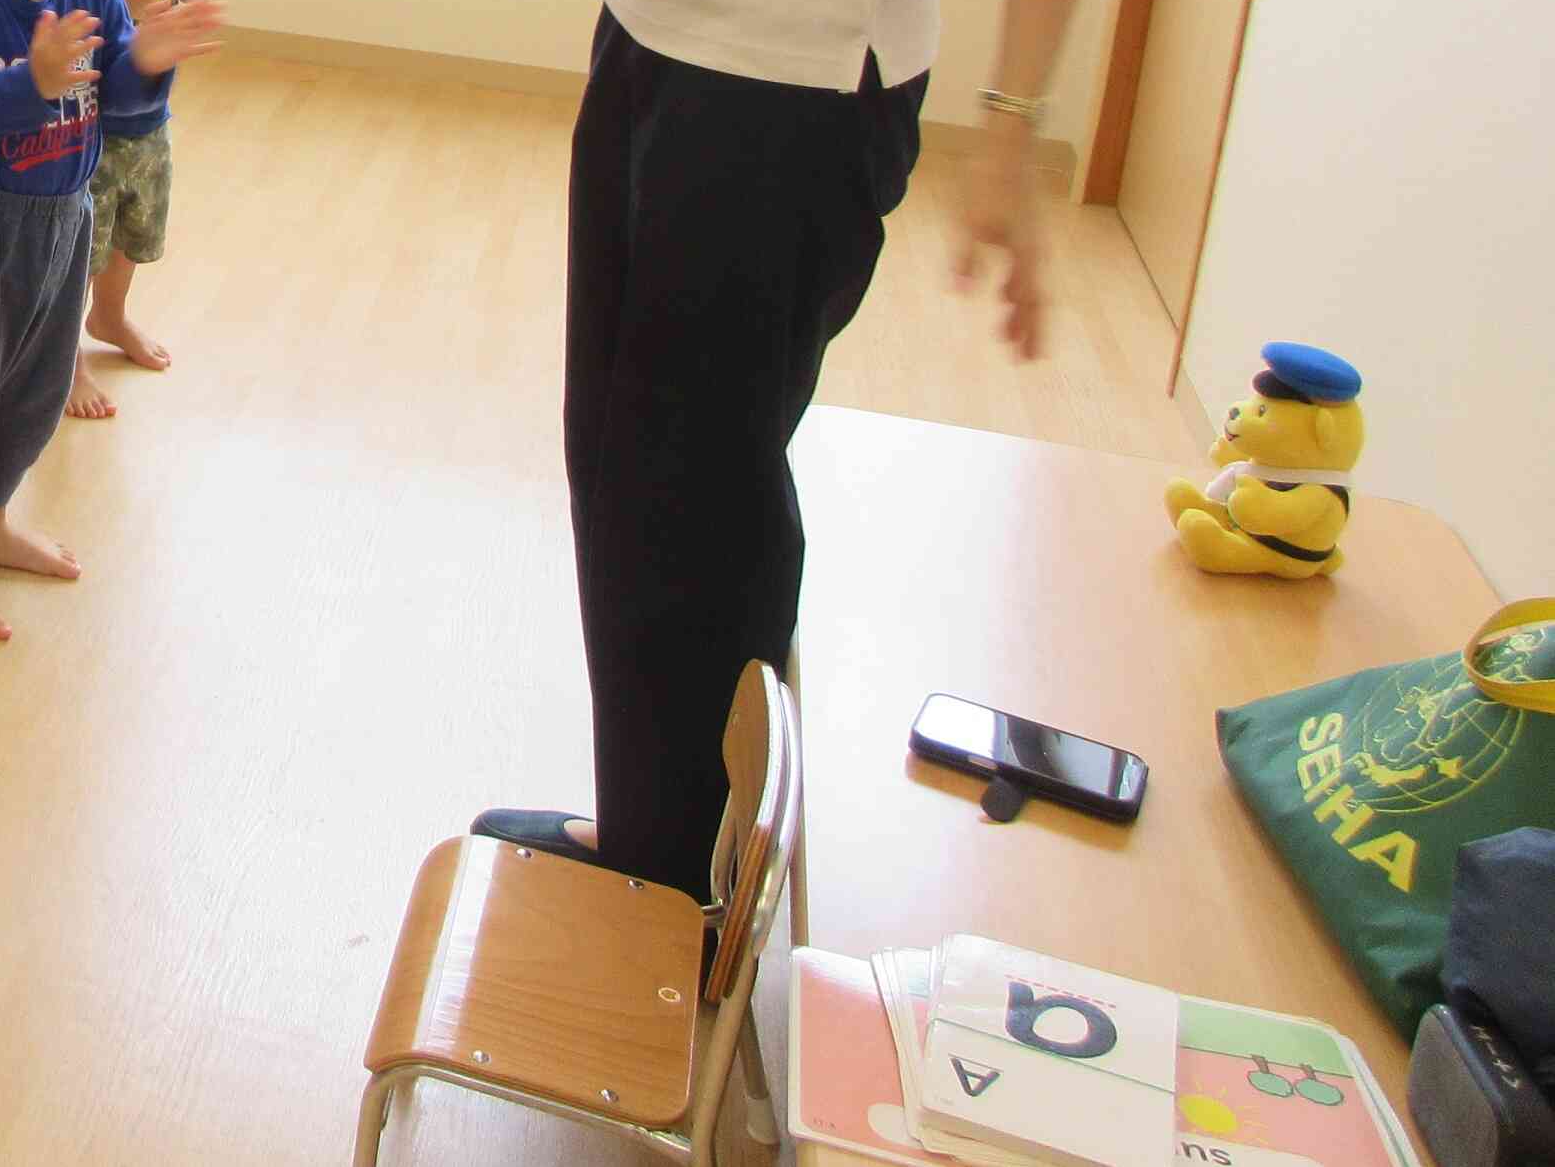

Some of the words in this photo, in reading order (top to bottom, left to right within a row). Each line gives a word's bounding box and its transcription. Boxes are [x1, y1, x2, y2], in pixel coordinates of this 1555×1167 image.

[1297, 712, 1421, 894] SEIHA
[950, 1056, 1001, 1098] A
[1176, 1140, 1232, 1166] su
